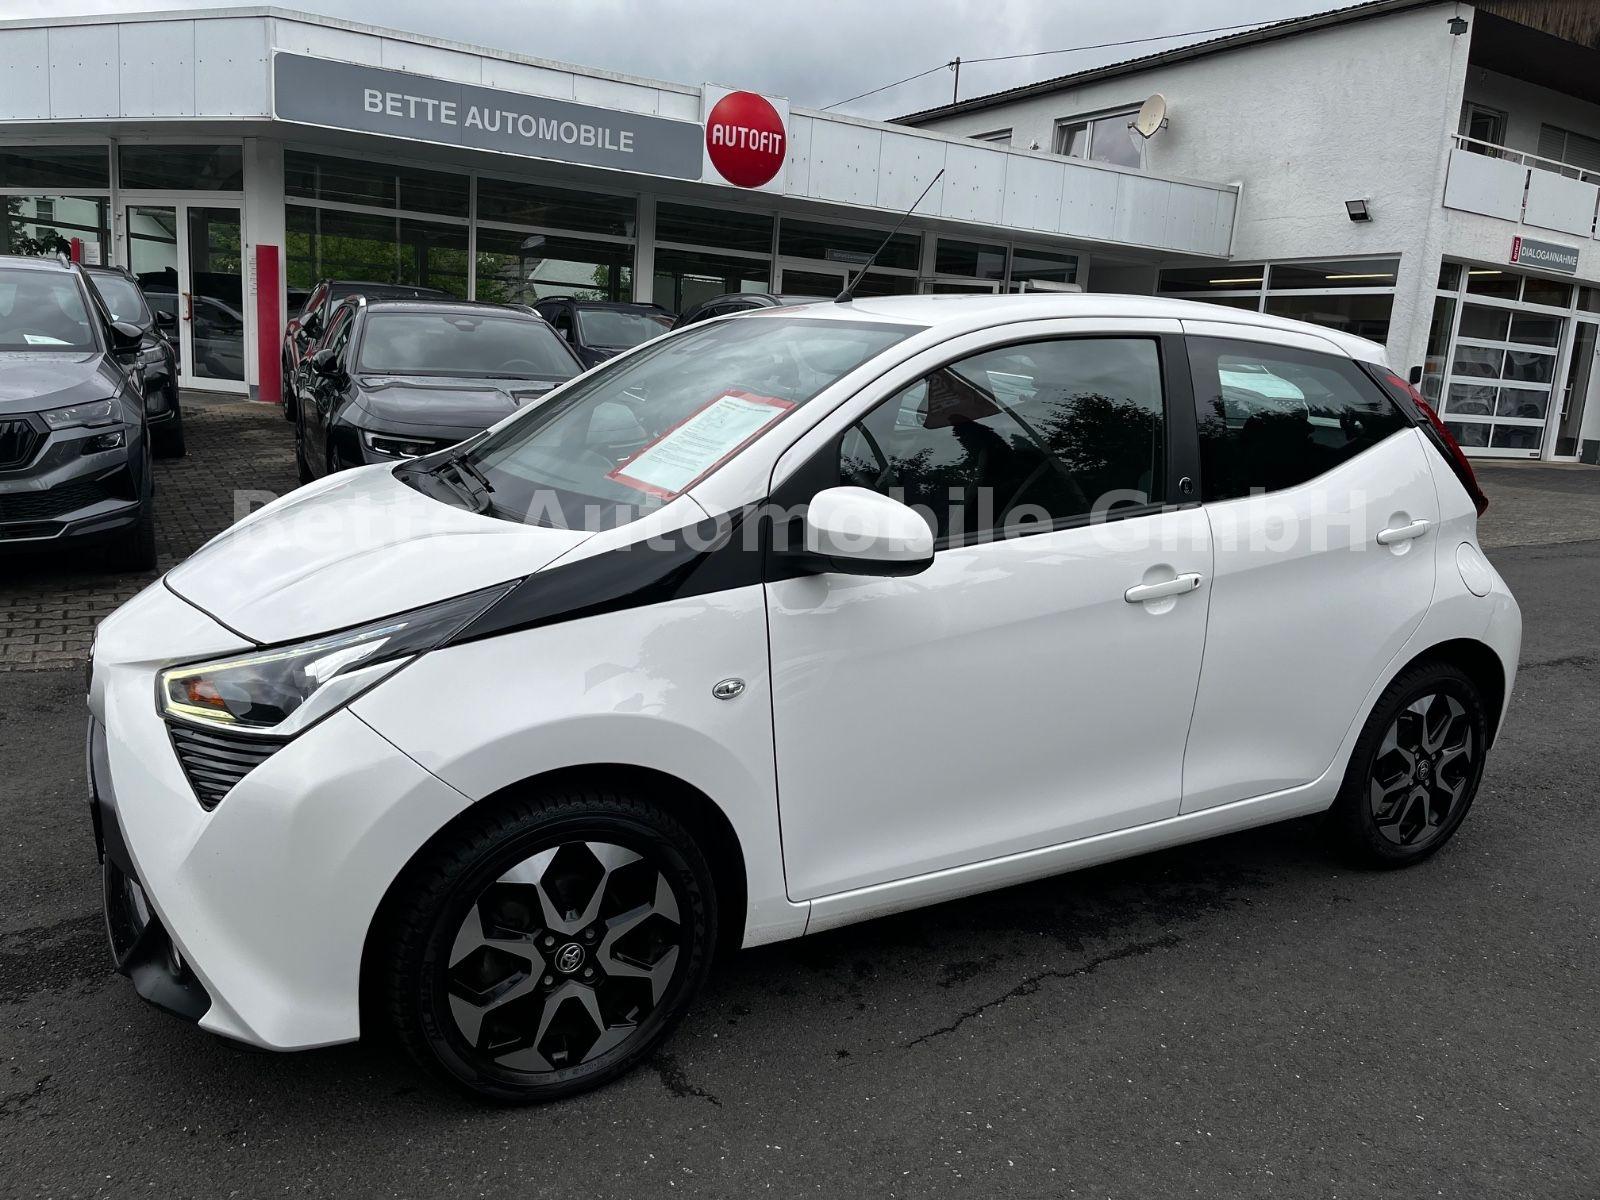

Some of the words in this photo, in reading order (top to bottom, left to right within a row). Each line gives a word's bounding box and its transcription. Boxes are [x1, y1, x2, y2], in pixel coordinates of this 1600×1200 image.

[364, 88, 457, 126] BETTE
[464, 105, 635, 153] AUTOMOBILE
[711, 123, 784, 156] AUTOFIT
[1521, 246, 1578, 266] DIALOGANNAHME
